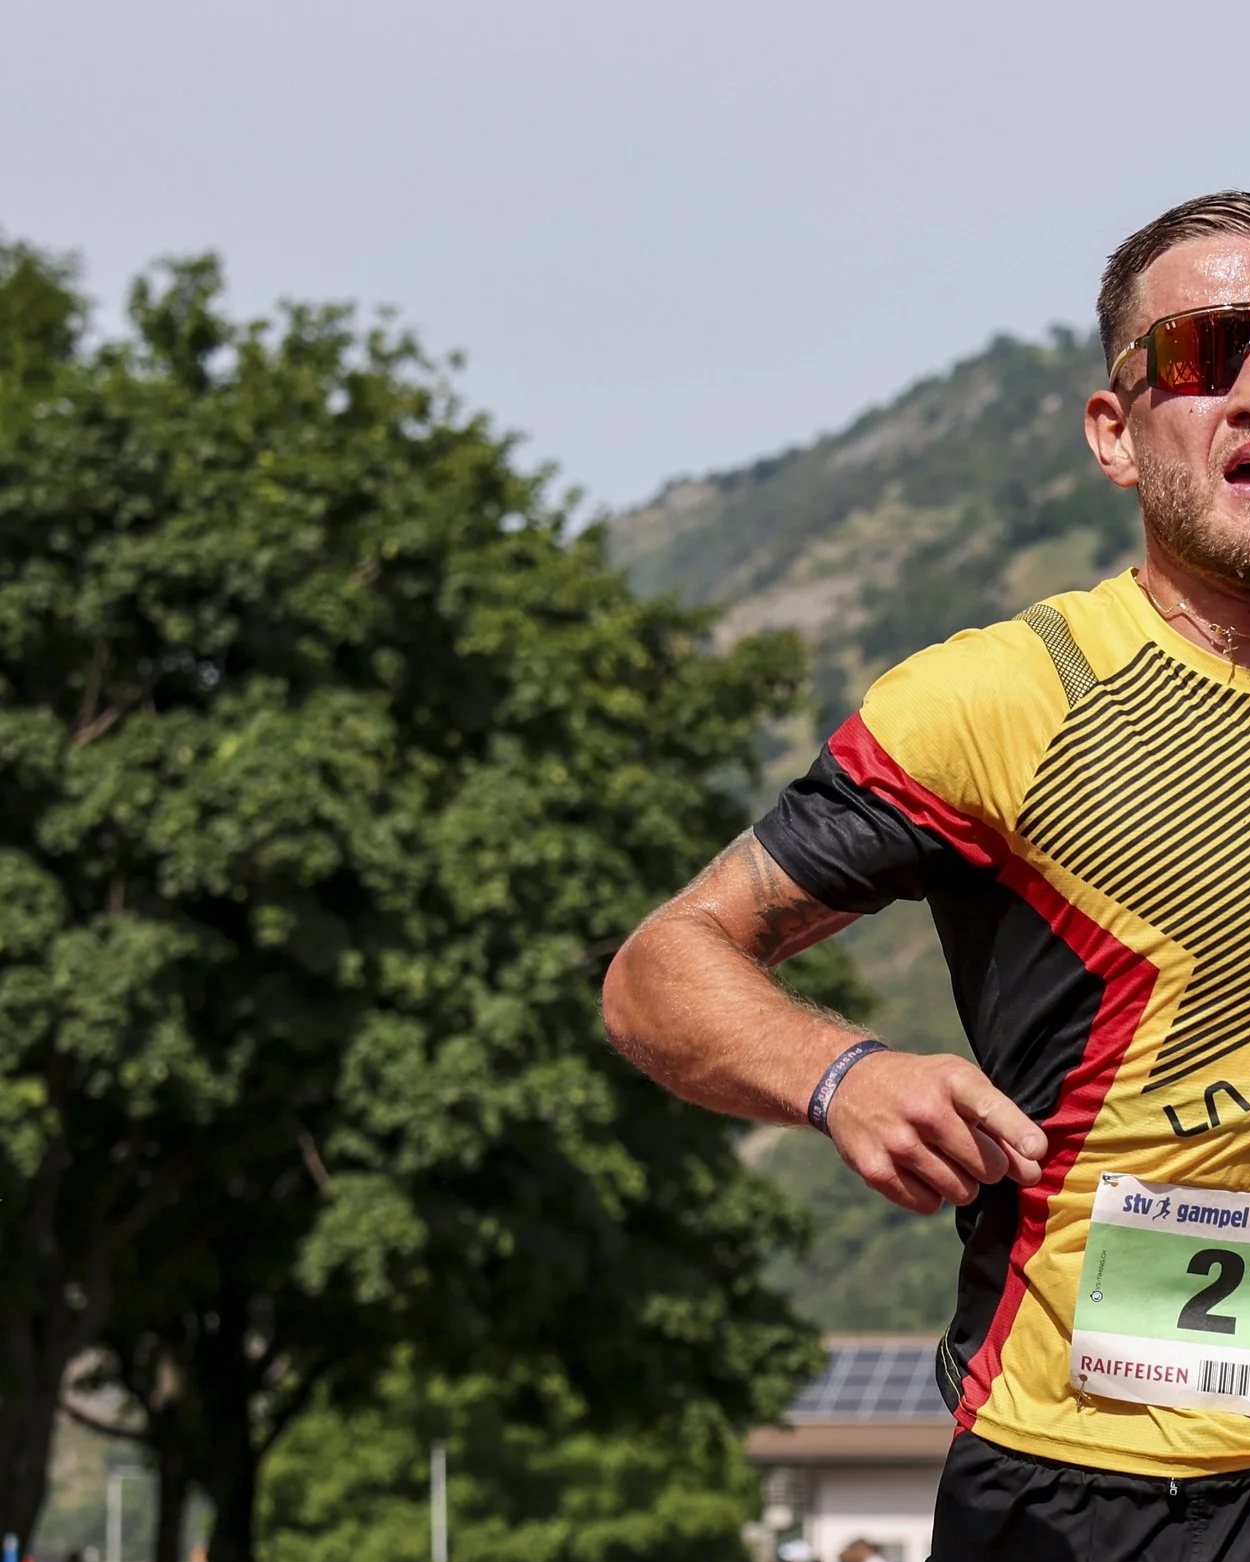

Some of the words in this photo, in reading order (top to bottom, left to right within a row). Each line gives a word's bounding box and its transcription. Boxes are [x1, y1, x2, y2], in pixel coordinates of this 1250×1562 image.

[1122, 1193, 1154, 1215] stv
[1176, 1203, 1250, 1229] gampel
[1080, 1355, 1189, 1384] RAIFFEISEN
